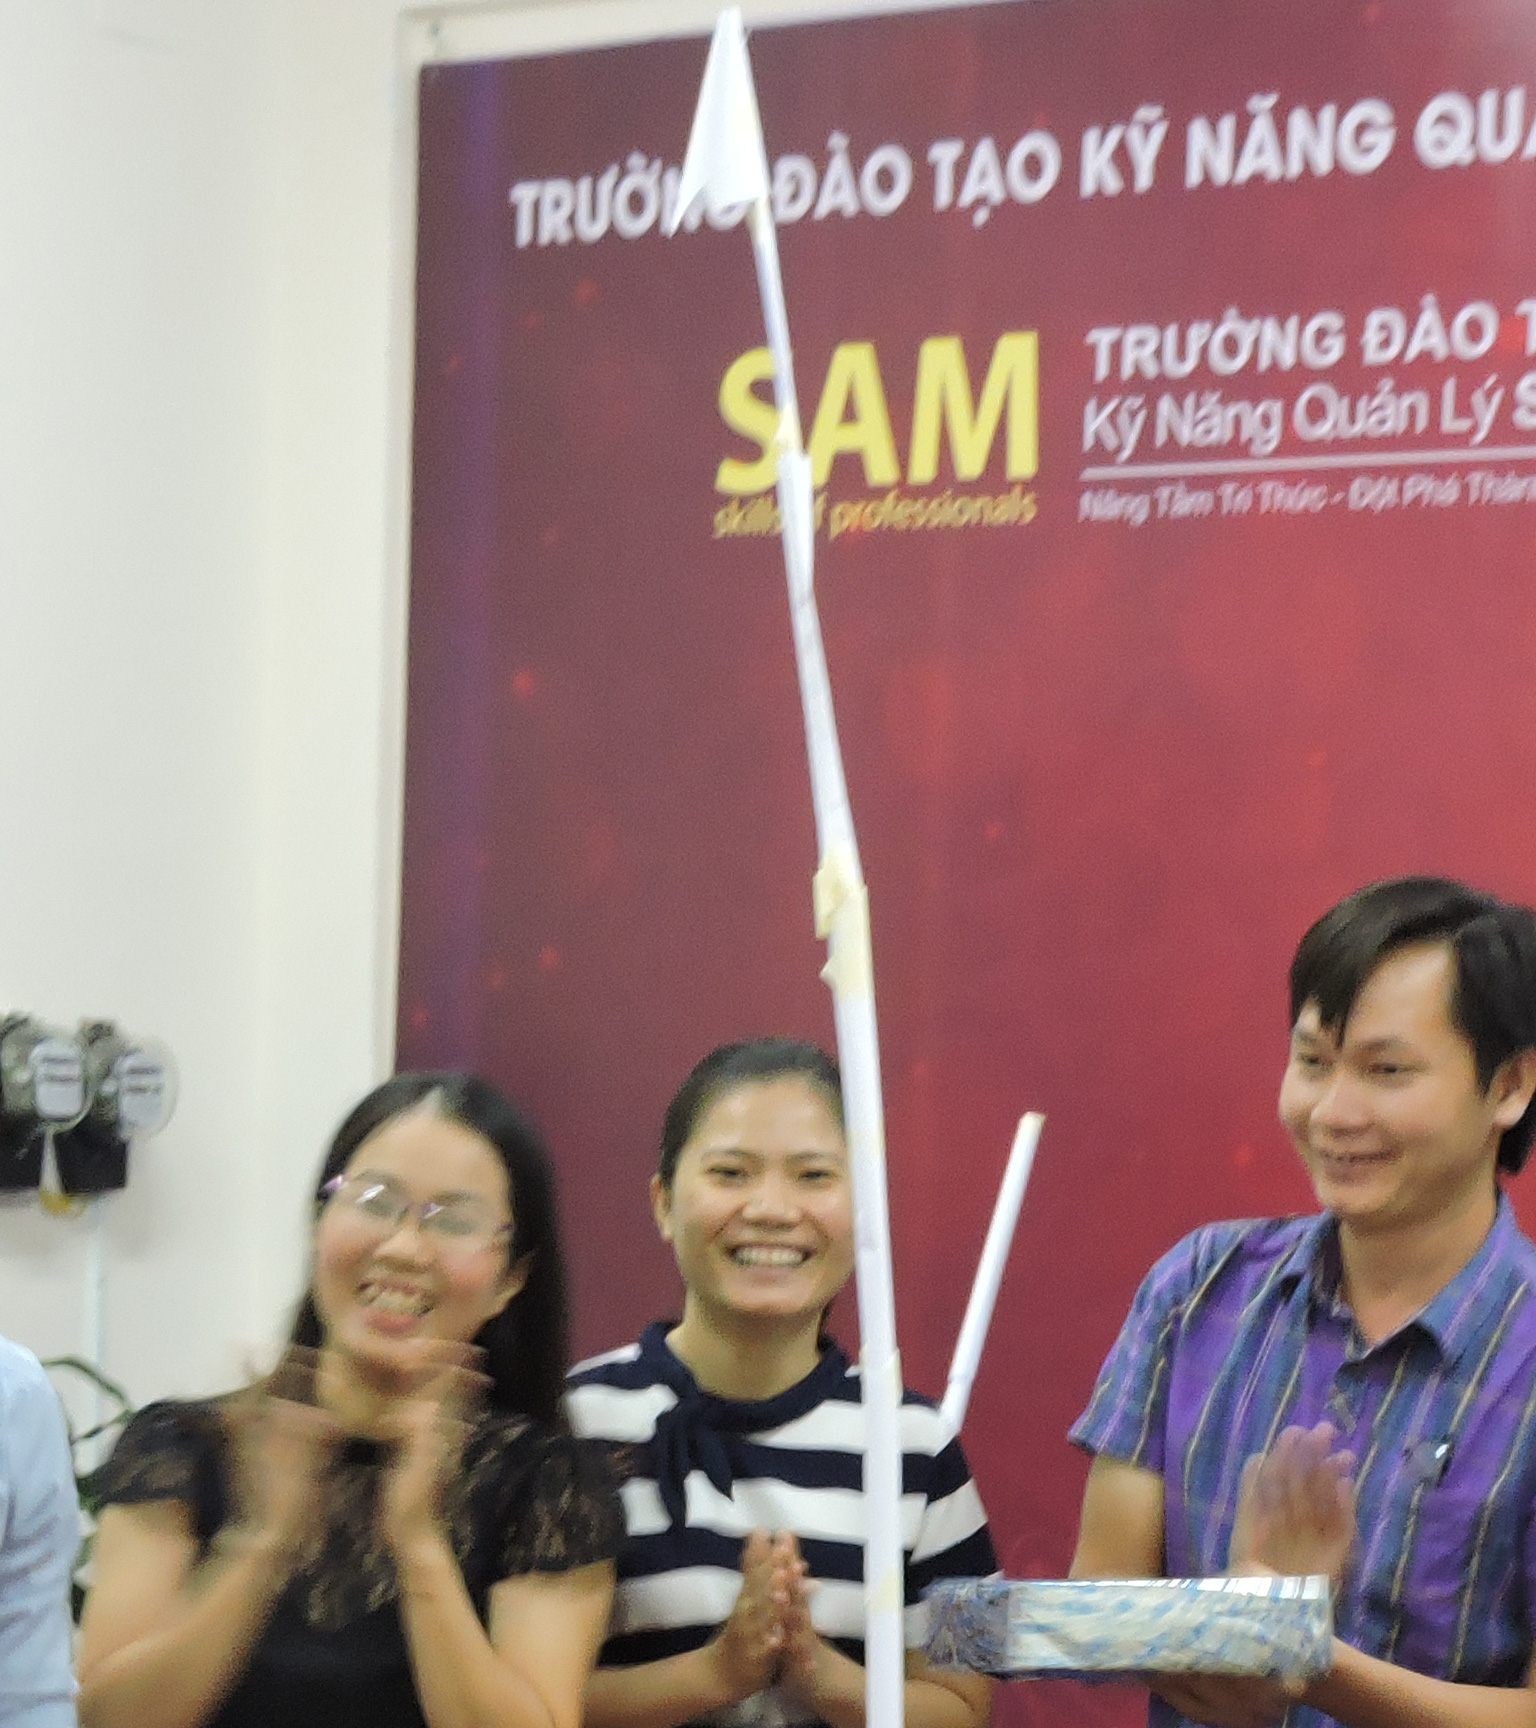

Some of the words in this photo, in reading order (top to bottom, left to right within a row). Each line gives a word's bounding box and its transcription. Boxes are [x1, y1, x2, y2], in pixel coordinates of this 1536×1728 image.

[927, 130, 1062, 230] TẠO
[1078, 102, 1169, 198] KỸ
[1184, 92, 1396, 190] NĂNG
[1084, 305, 1346, 384] TRƯỜNG
[1360, 293, 1500, 367] ĐÀO
[714, 330, 1039, 496] SAM
[1081, 397, 1146, 463] Kỹ
[1155, 391, 1283, 456] Năng
[1293, 378, 1429, 442] Quản
[1441, 376, 1504, 443] Lý
